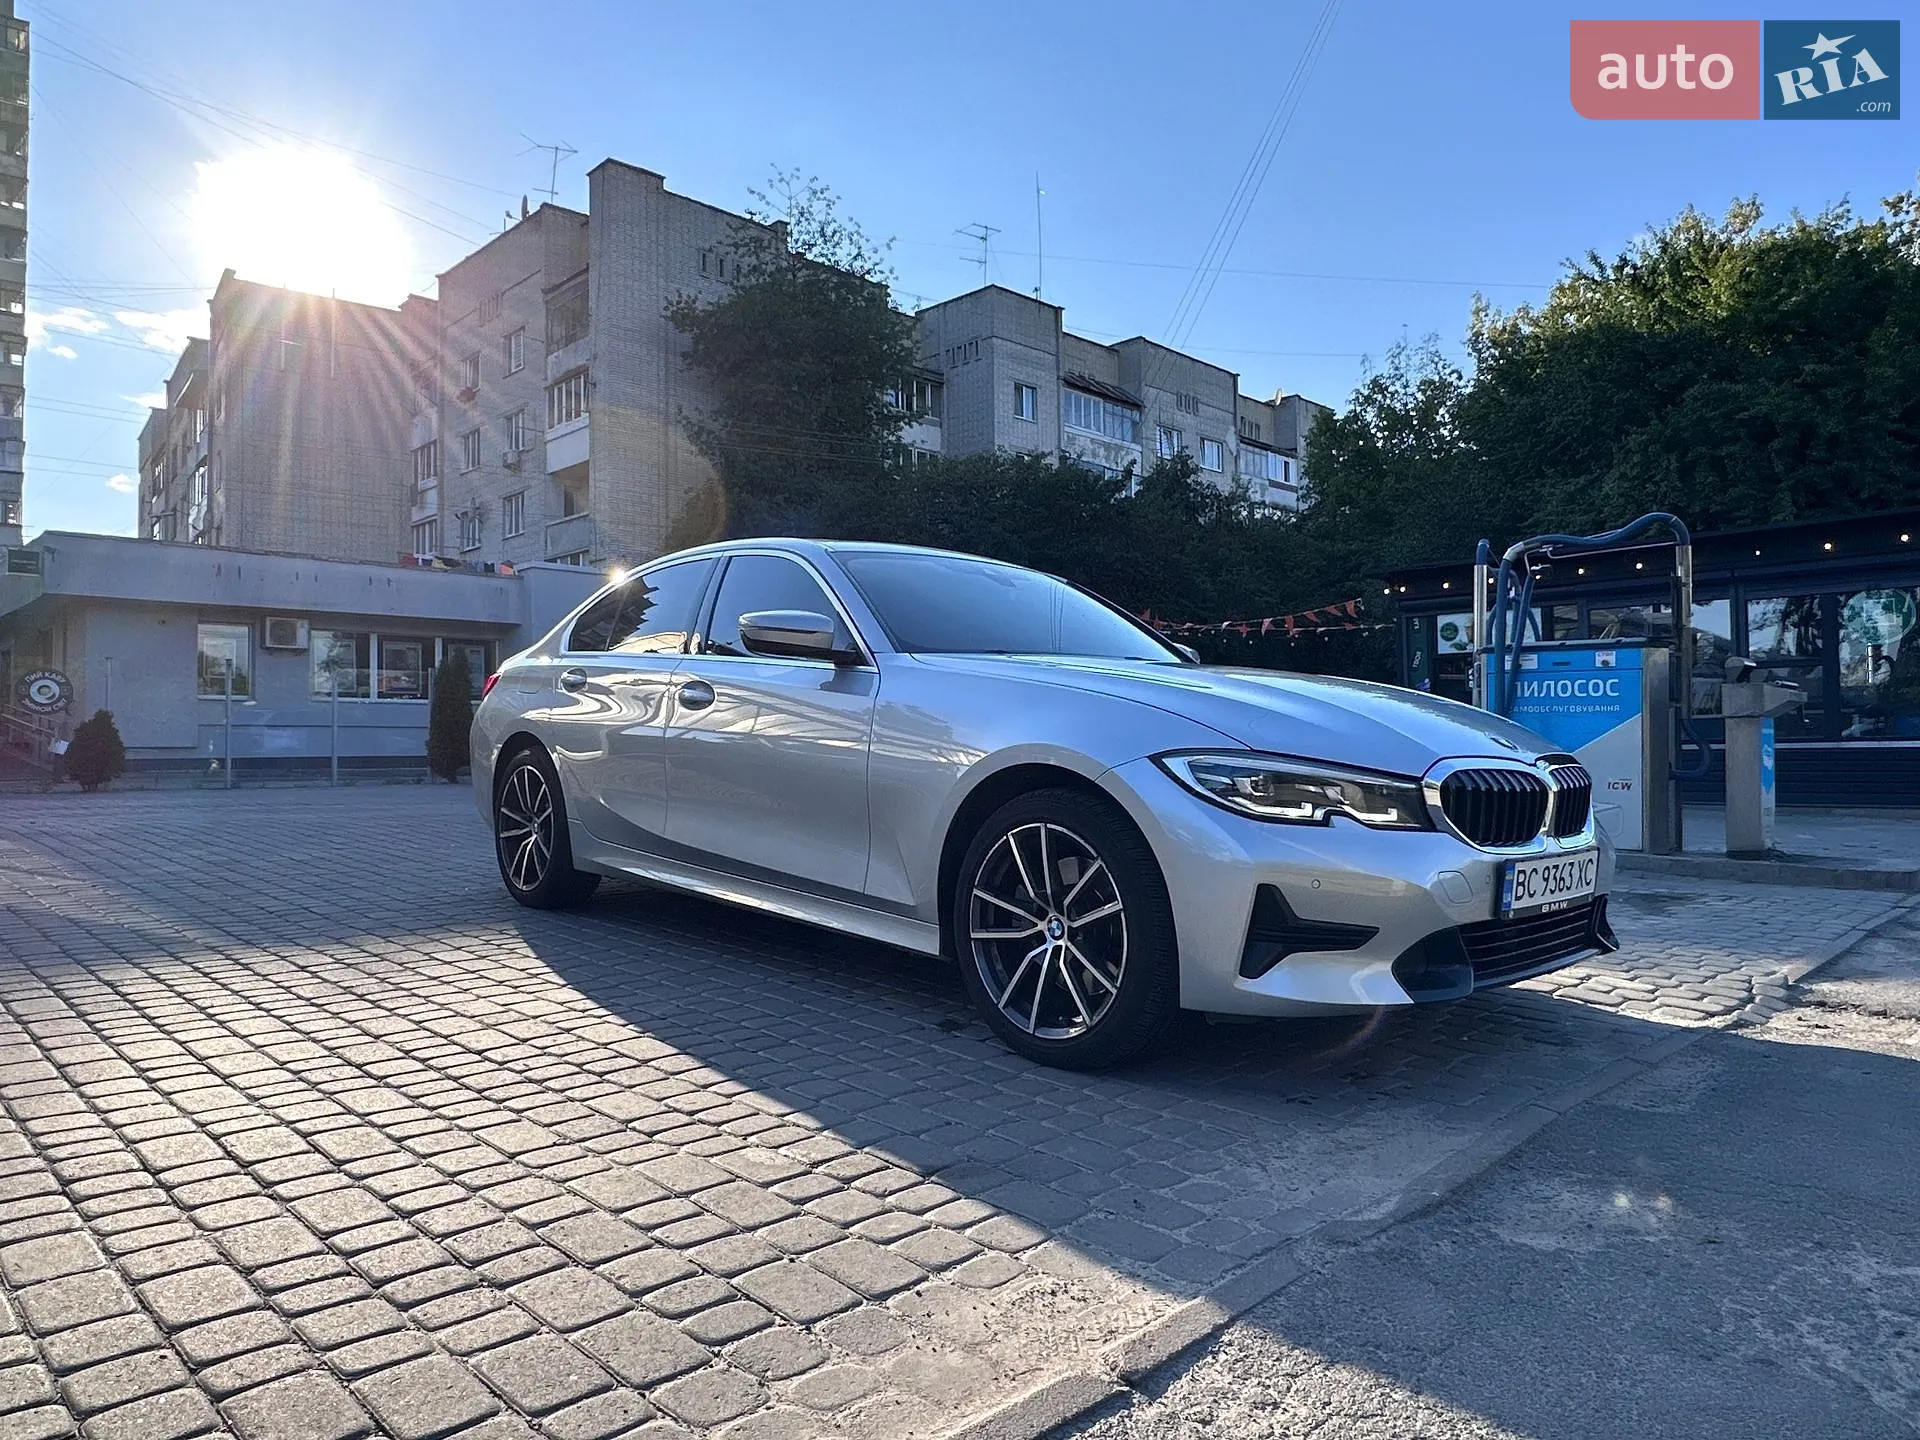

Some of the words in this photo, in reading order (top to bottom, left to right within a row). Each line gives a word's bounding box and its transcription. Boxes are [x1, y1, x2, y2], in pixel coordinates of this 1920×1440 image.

[1513, 704, 1620, 713] АМООБСЛУГОВУВАННЯ
[1515, 869, 1538, 901] BC
[1541, 861, 1575, 896] 9363
[1575, 858, 1594, 889] XC
[1541, 901, 1568, 913] BMW
